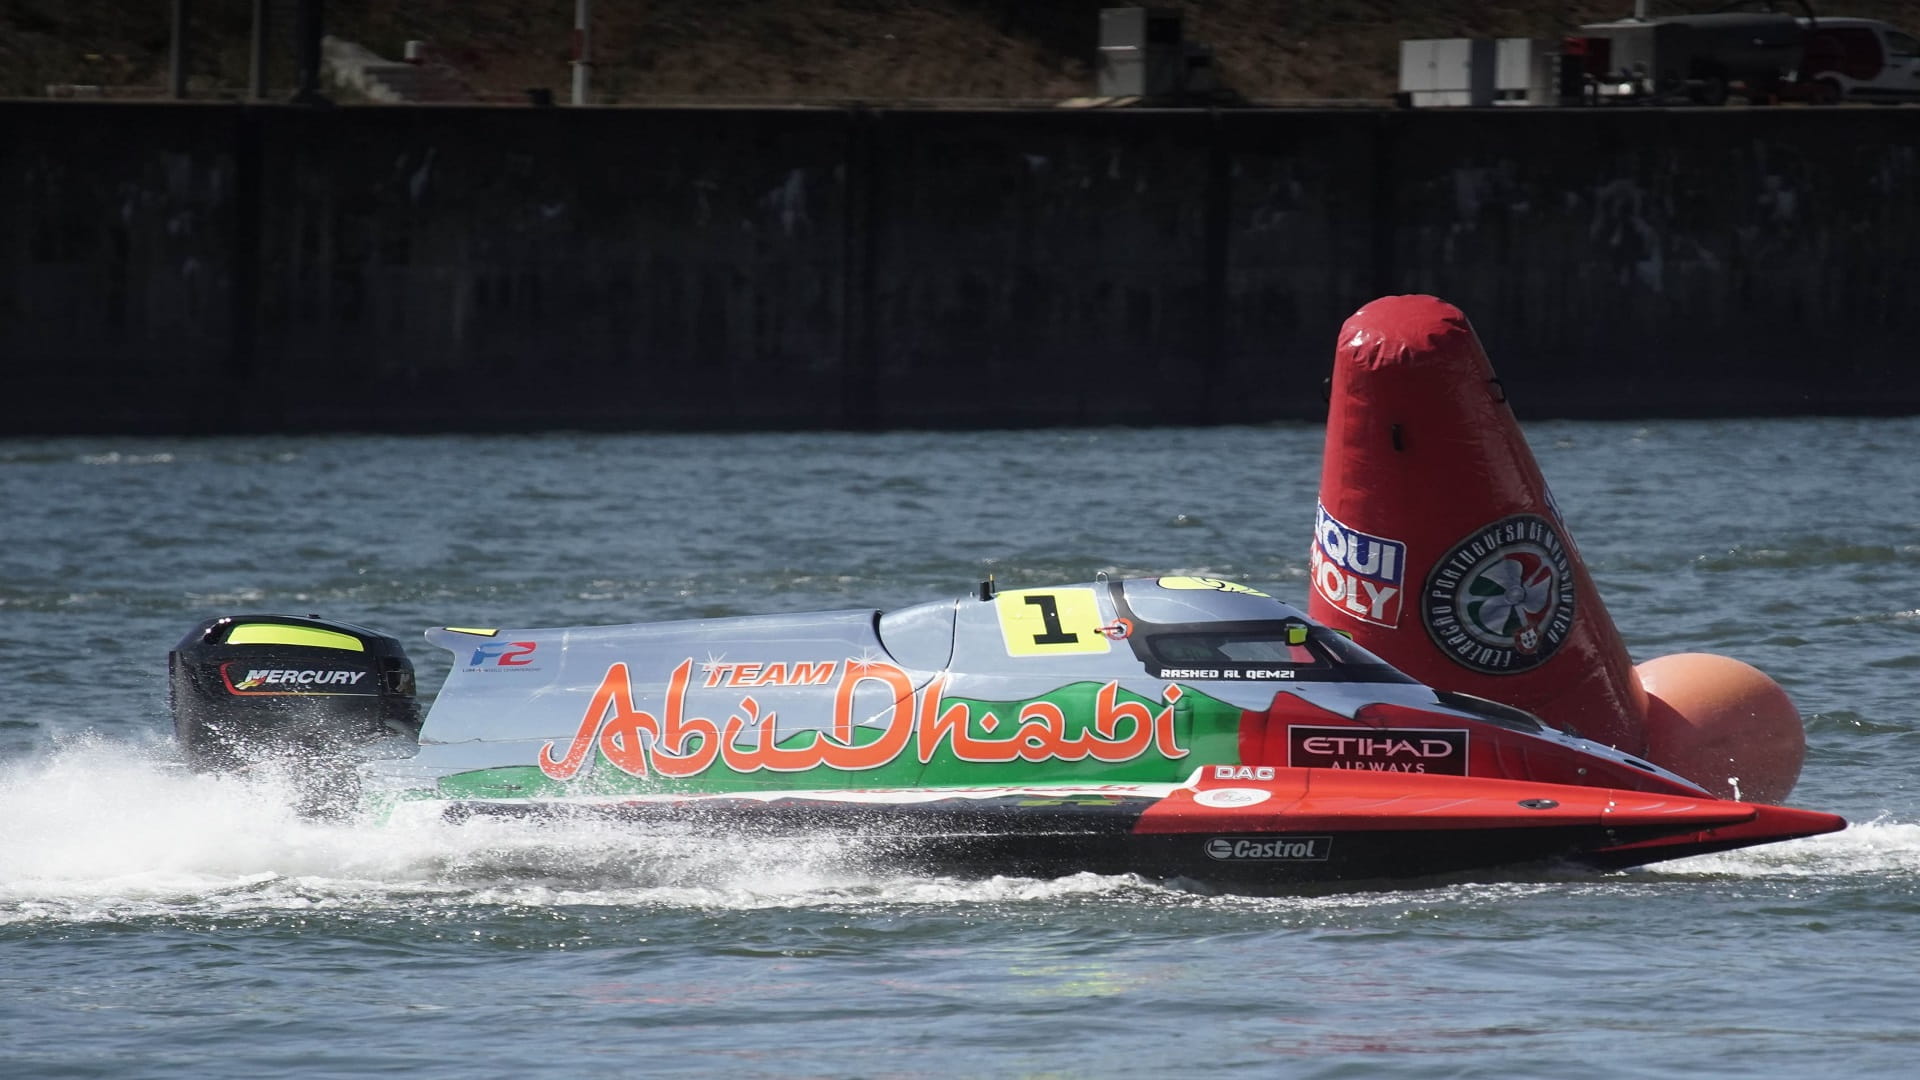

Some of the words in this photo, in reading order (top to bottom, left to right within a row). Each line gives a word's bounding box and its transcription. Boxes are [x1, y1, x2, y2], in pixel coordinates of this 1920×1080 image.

[1431, 521, 1525, 599] PORTUGUESA
[1529, 521, 1543, 541] DE
[1311, 540, 1398, 620] MOLY
[1024, 595, 1079, 645] 1
[470, 641, 537, 666] F2
[243, 669, 366, 685] MERCURY
[701, 660, 838, 688] TEAM
[1160, 669, 1219, 678] RASHED
[1223, 669, 1241, 678] AL
[1303, 736, 1453, 757] ETIHAD
[1234, 839, 1315, 858] Castrol
